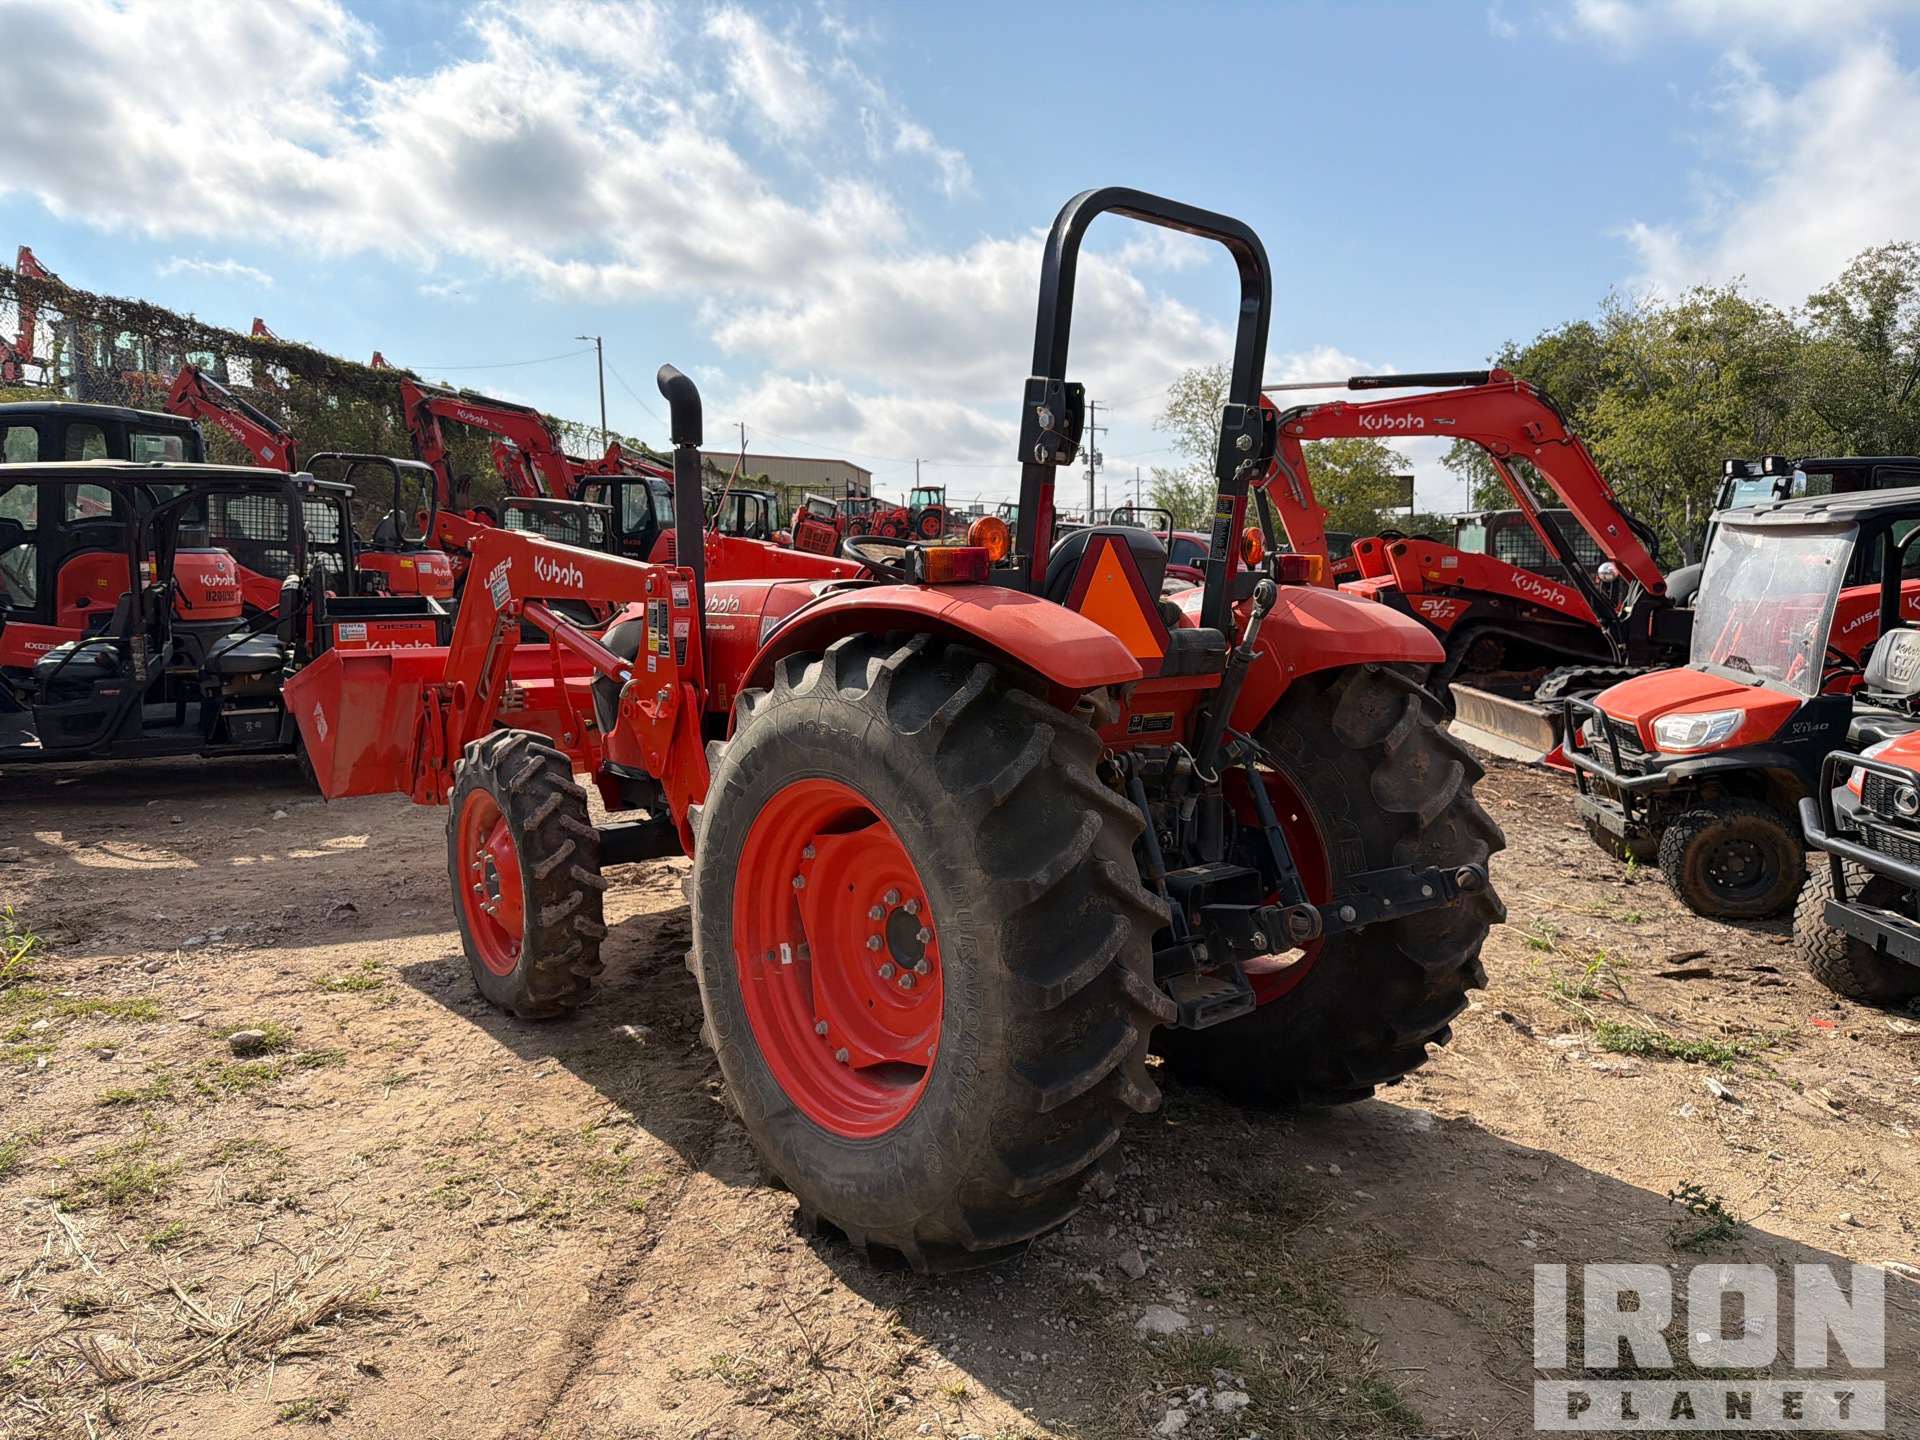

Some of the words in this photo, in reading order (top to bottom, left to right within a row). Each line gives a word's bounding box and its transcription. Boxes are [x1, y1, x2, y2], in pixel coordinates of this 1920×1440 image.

[457, 409, 489, 426] Kubota
[1359, 413, 1425, 430] Kubota
[220, 416, 246, 440] Kubota
[200, 574, 236, 586] Kubota
[484, 556, 512, 590] LA1154
[534, 555, 584, 589] Kubota
[1511, 572, 1566, 606] Kubota
[705, 594, 740, 612] ubota
[1420, 600, 1455, 610] SVL
[798, 720, 861, 748] 16.9-30
[1792, 723, 1829, 734] X1140
